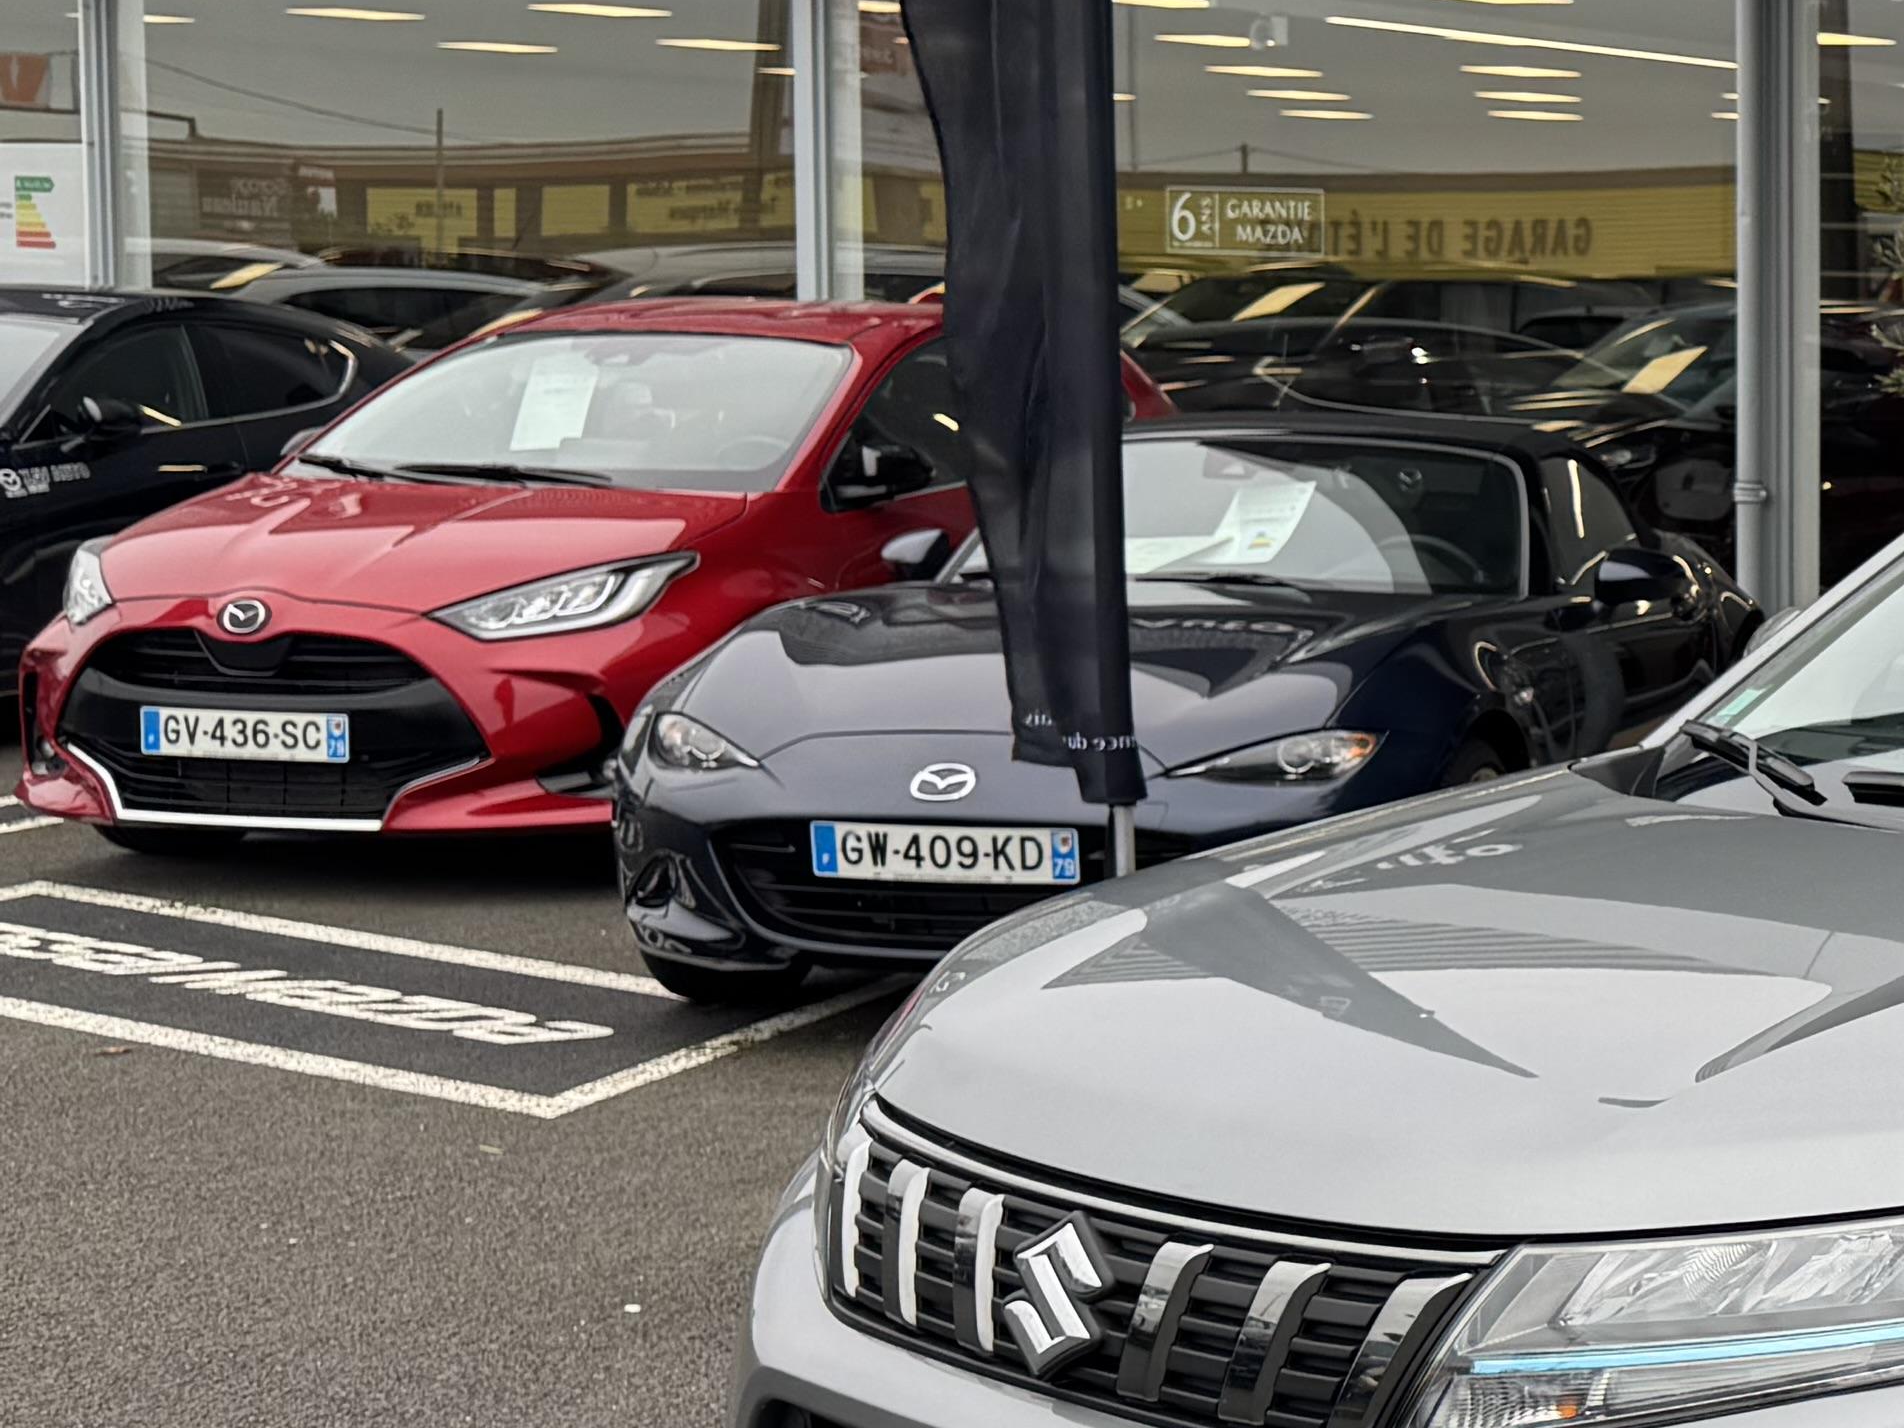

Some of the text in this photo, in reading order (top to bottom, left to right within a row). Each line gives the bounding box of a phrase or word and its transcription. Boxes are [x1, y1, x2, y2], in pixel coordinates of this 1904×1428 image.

[1172, 192, 1197, 241] 6
[1226, 199, 1313, 221] GARANTIE
[1236, 224, 1304, 246] MAZDA
[841, 831, 1044, 872] GW-409-KD
